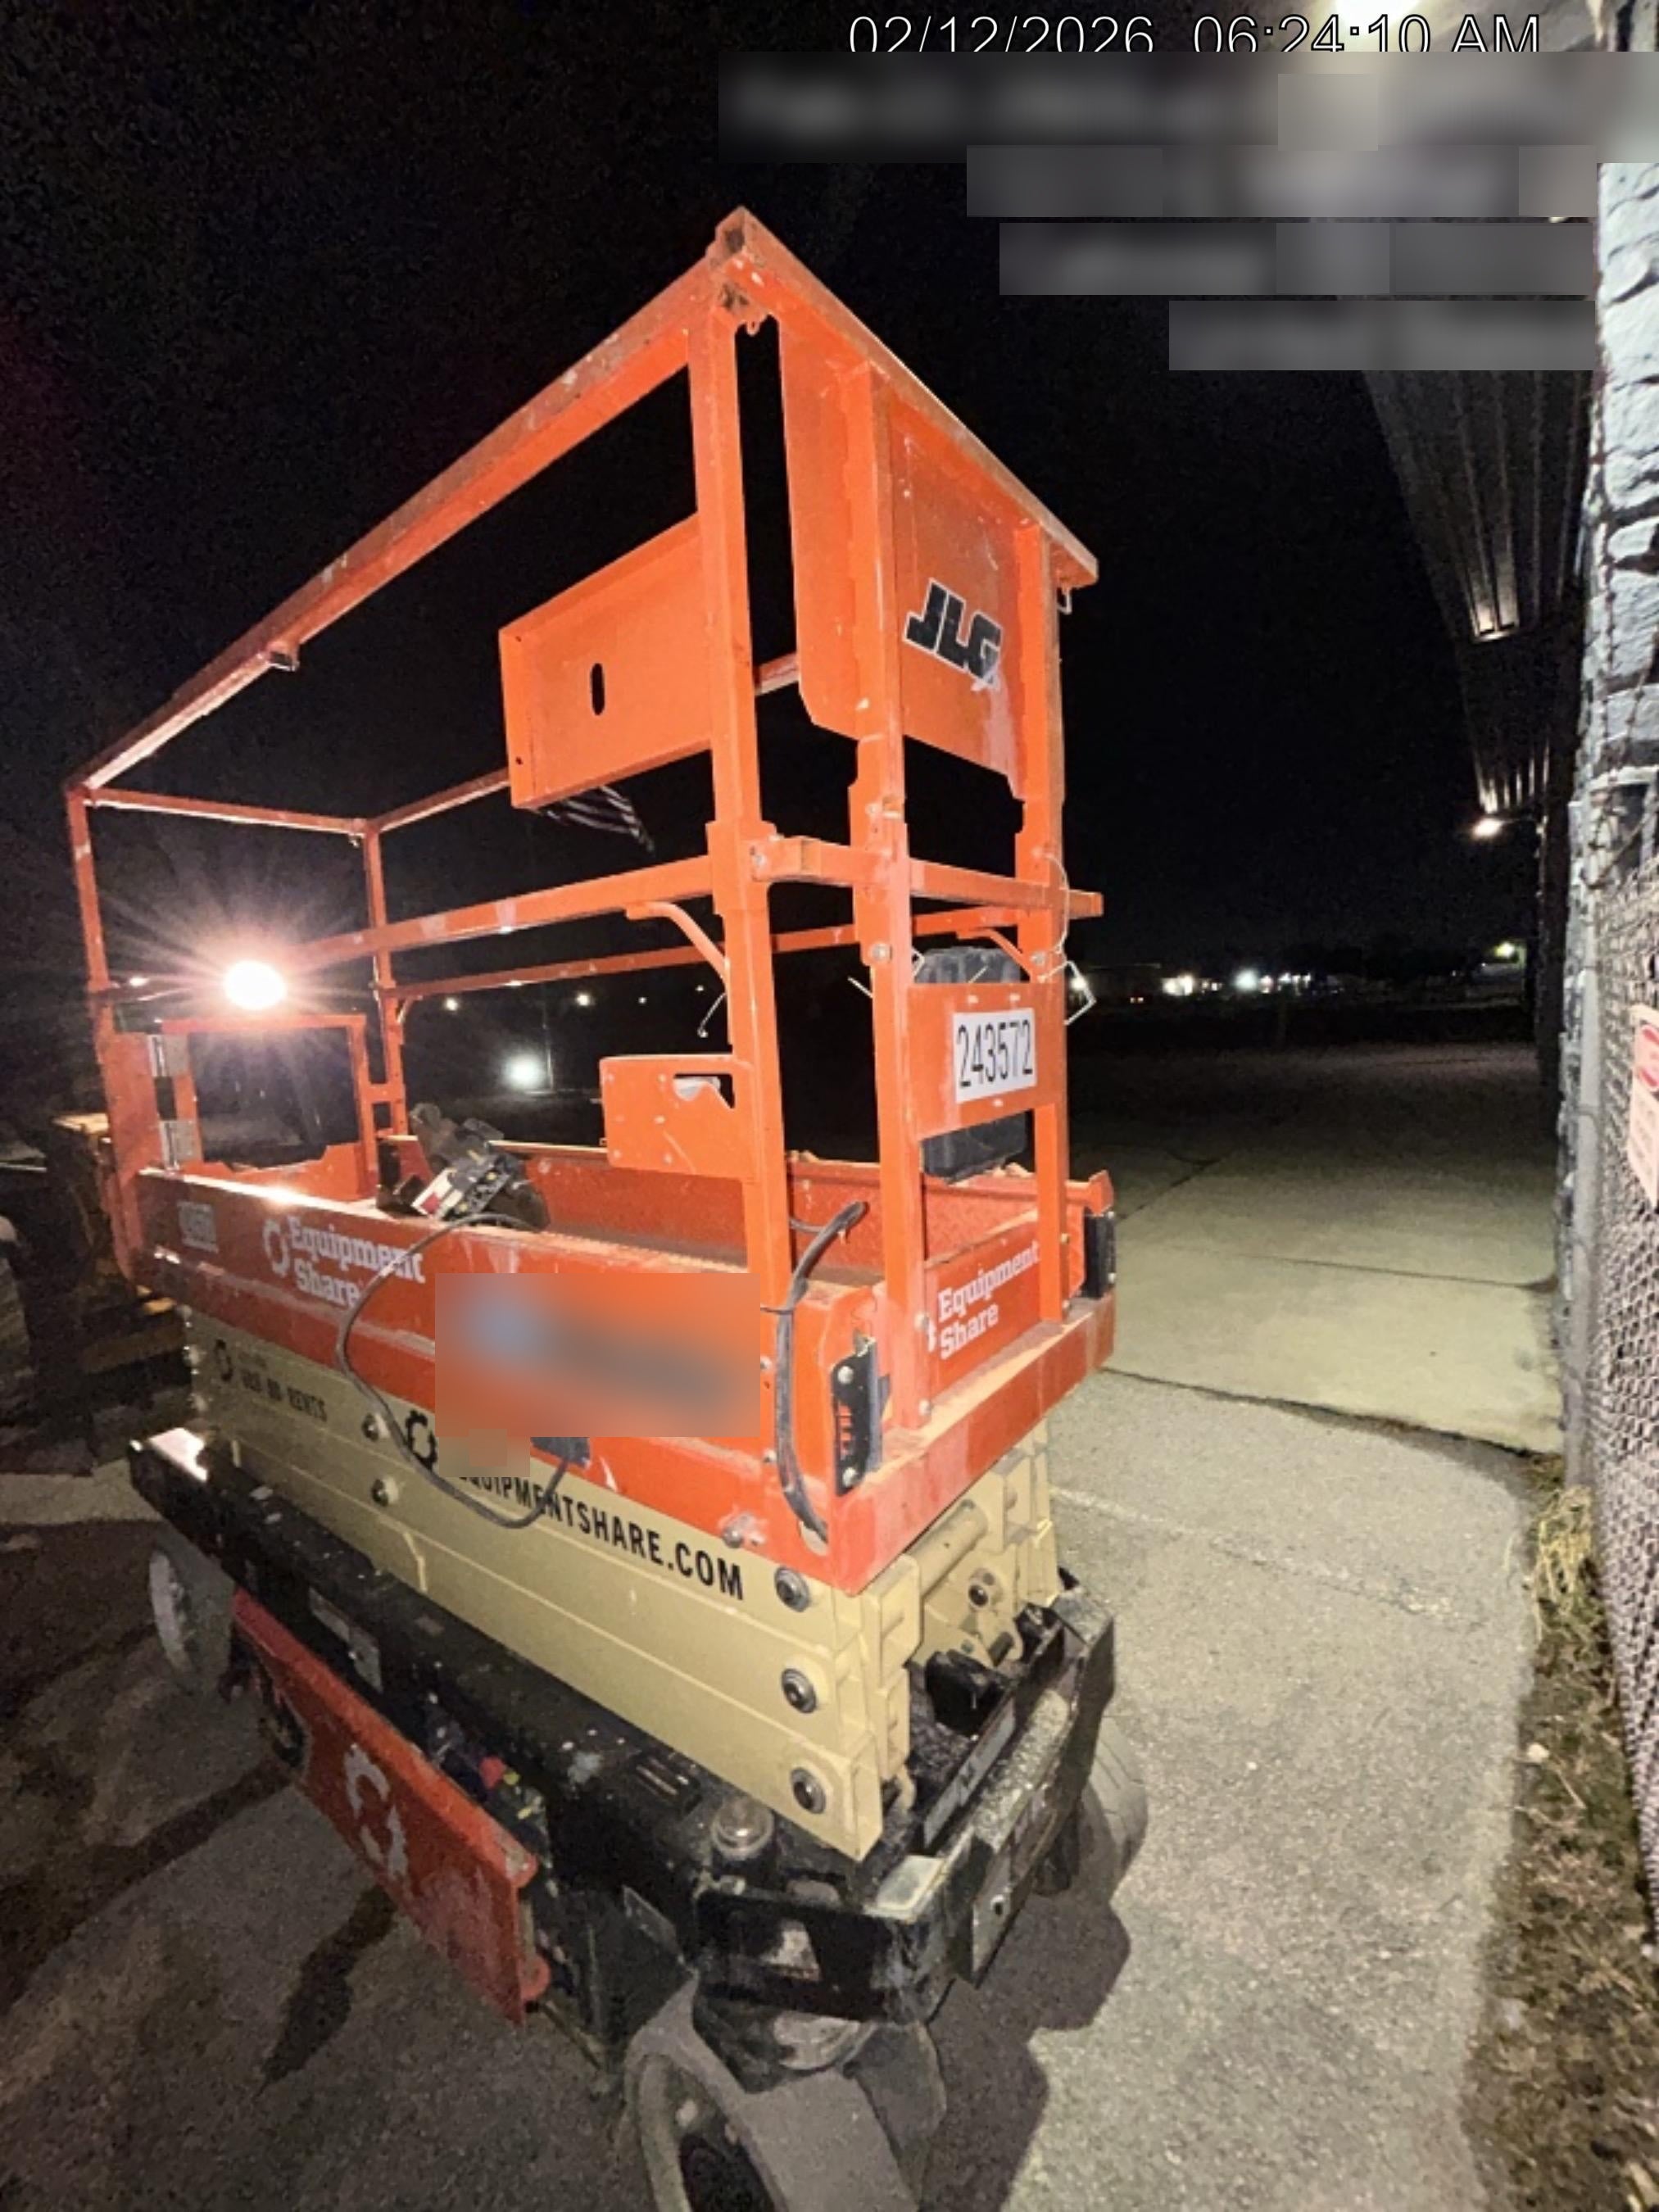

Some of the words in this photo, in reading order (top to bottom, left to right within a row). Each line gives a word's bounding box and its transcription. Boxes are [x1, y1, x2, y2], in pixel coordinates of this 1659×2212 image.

[904, 578, 1003, 685] JLG
[956, 1018, 1033, 1089] 243572
[288, 1215, 426, 1284] Equipment
[938, 1240, 1040, 1323] Equipment
[940, 1303, 999, 1360] Share
